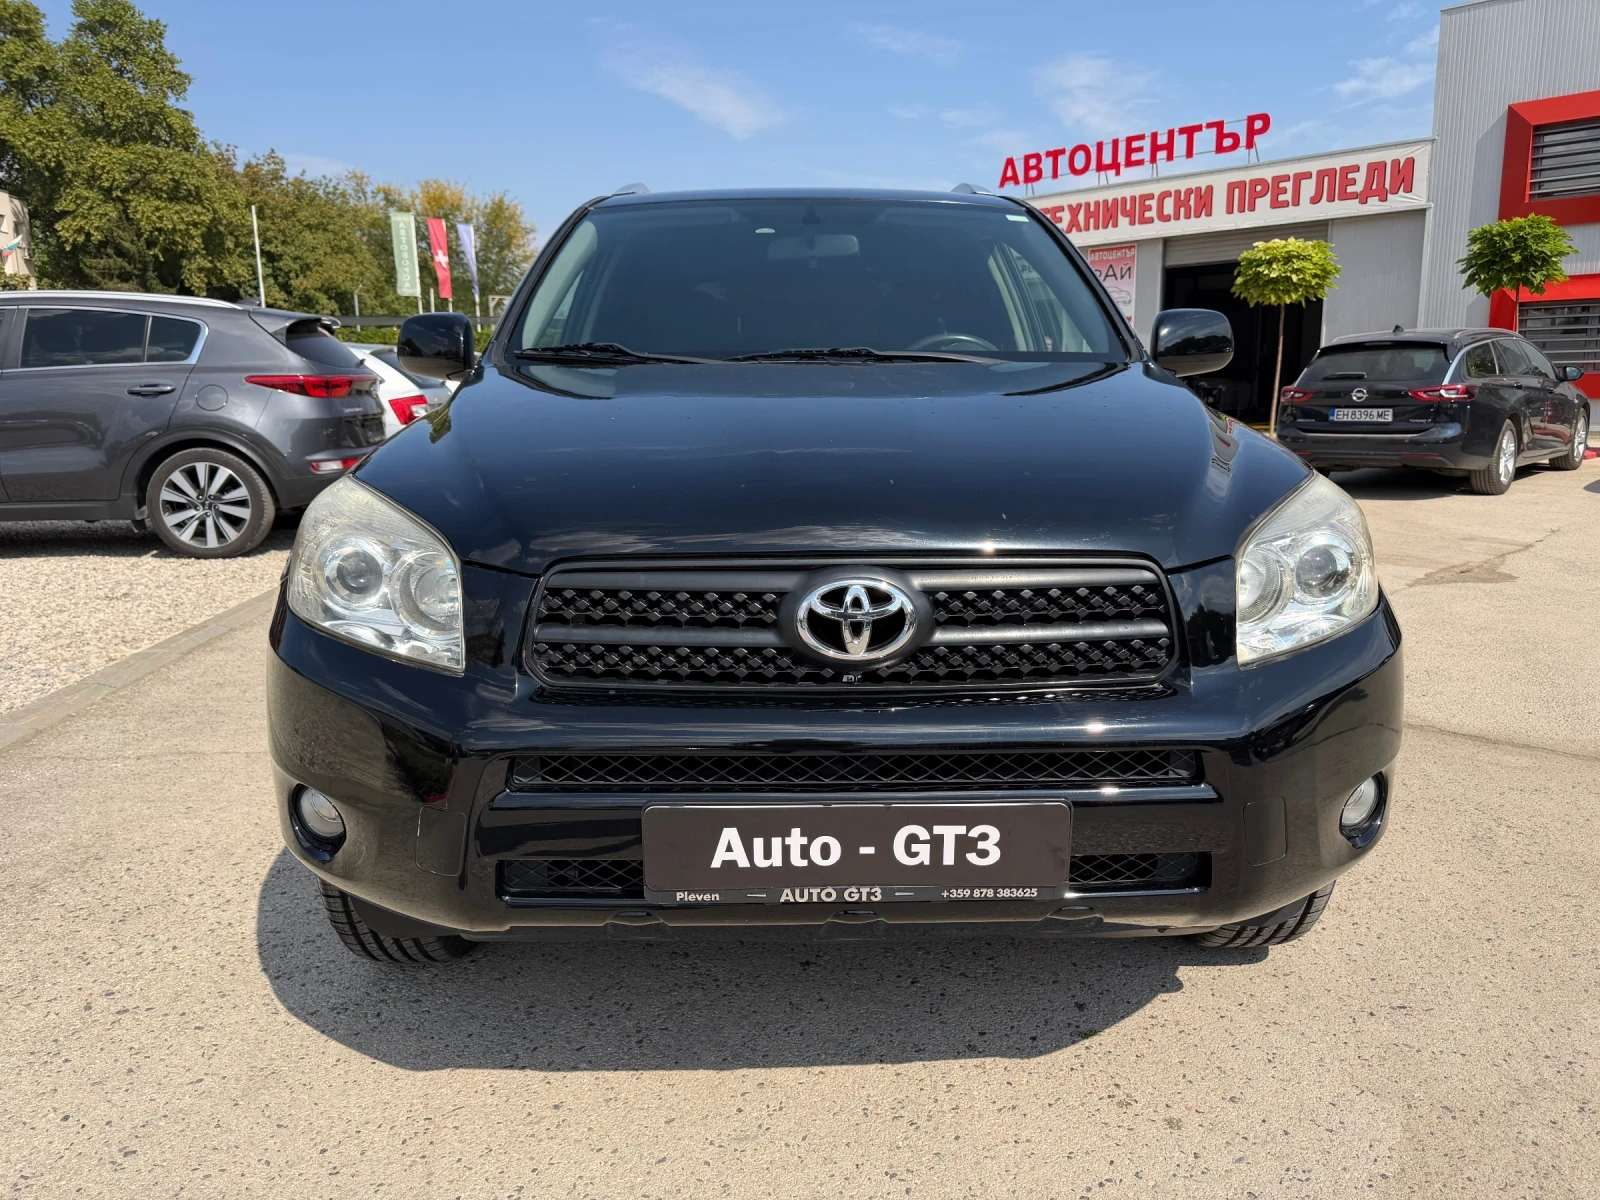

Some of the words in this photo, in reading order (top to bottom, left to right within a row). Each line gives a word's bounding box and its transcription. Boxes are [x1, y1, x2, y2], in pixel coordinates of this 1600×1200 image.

[998, 112, 1271, 189] АВТОЦЕНТЪР
[1226, 157, 1415, 215] ПРЕГЛЕДИ
[1089, 247, 1135, 261] АВТОЦЕНТЪР
[1350, 410, 1375, 420] 8396
[710, 827, 842, 869] Auto
[893, 824, 1001, 866] GT3
[676, 891, 720, 902] Pleven
[779, 886, 837, 904] AUTO
[843, 886, 883, 903] GT3
[941, 888, 971, 898] +359
[973, 888, 995, 898] 878
[996, 887, 1038, 898] 383625
